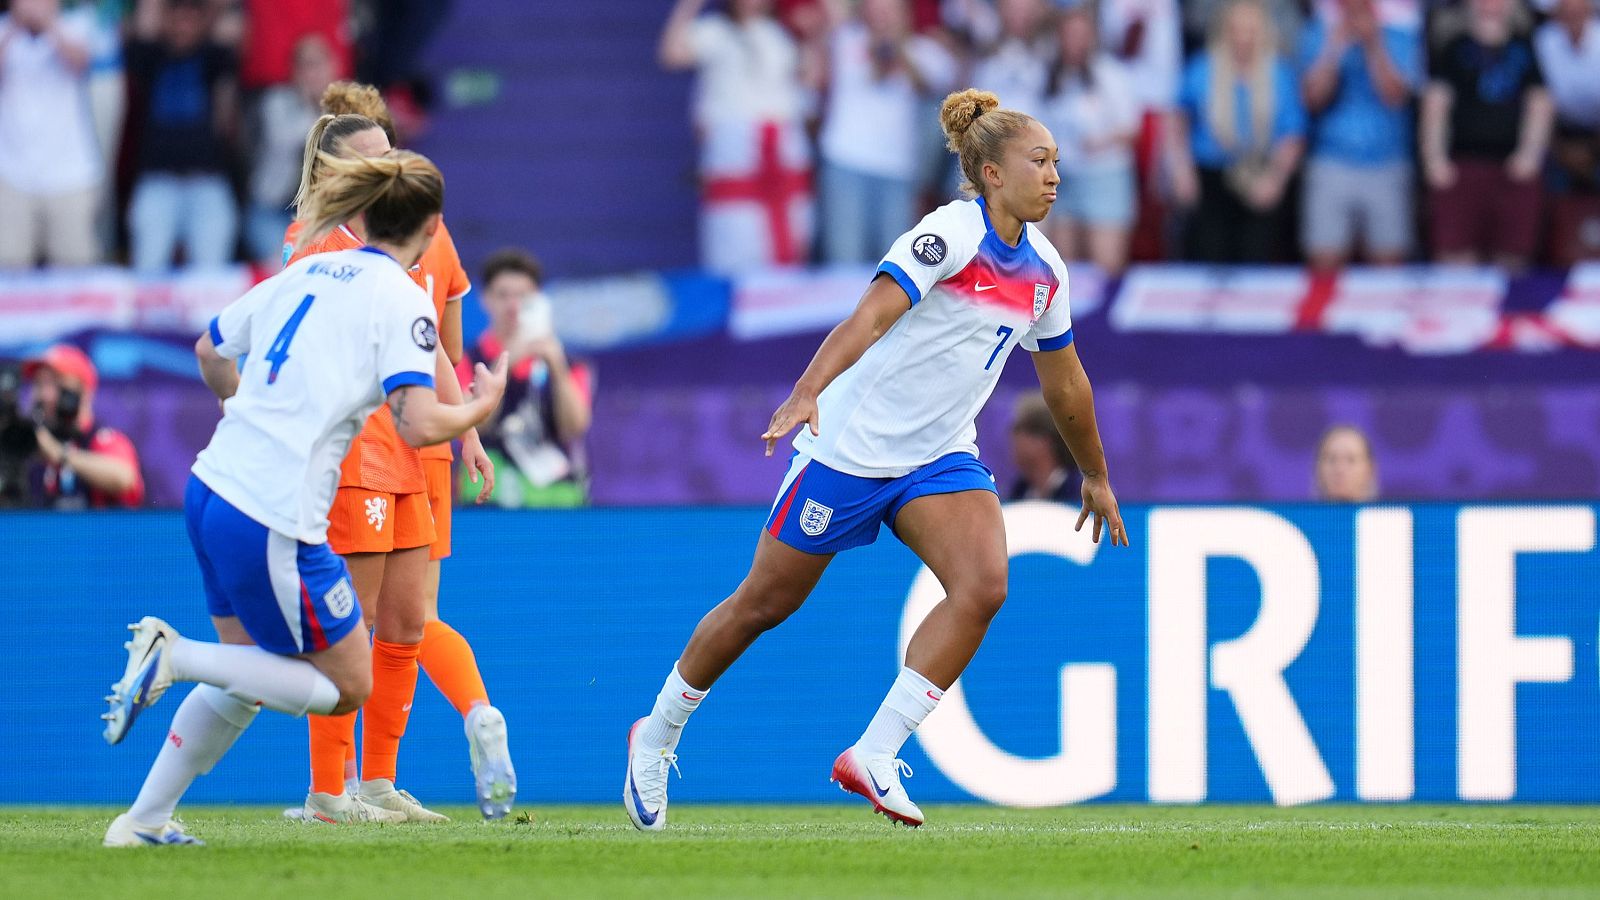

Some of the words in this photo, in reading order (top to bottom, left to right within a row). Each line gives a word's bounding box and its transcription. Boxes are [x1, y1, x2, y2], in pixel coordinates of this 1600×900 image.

[306, 262, 363, 283] WASH
[264, 294, 316, 385] 4
[984, 325, 1014, 371] 7
[898, 500, 1596, 806] GRIF
